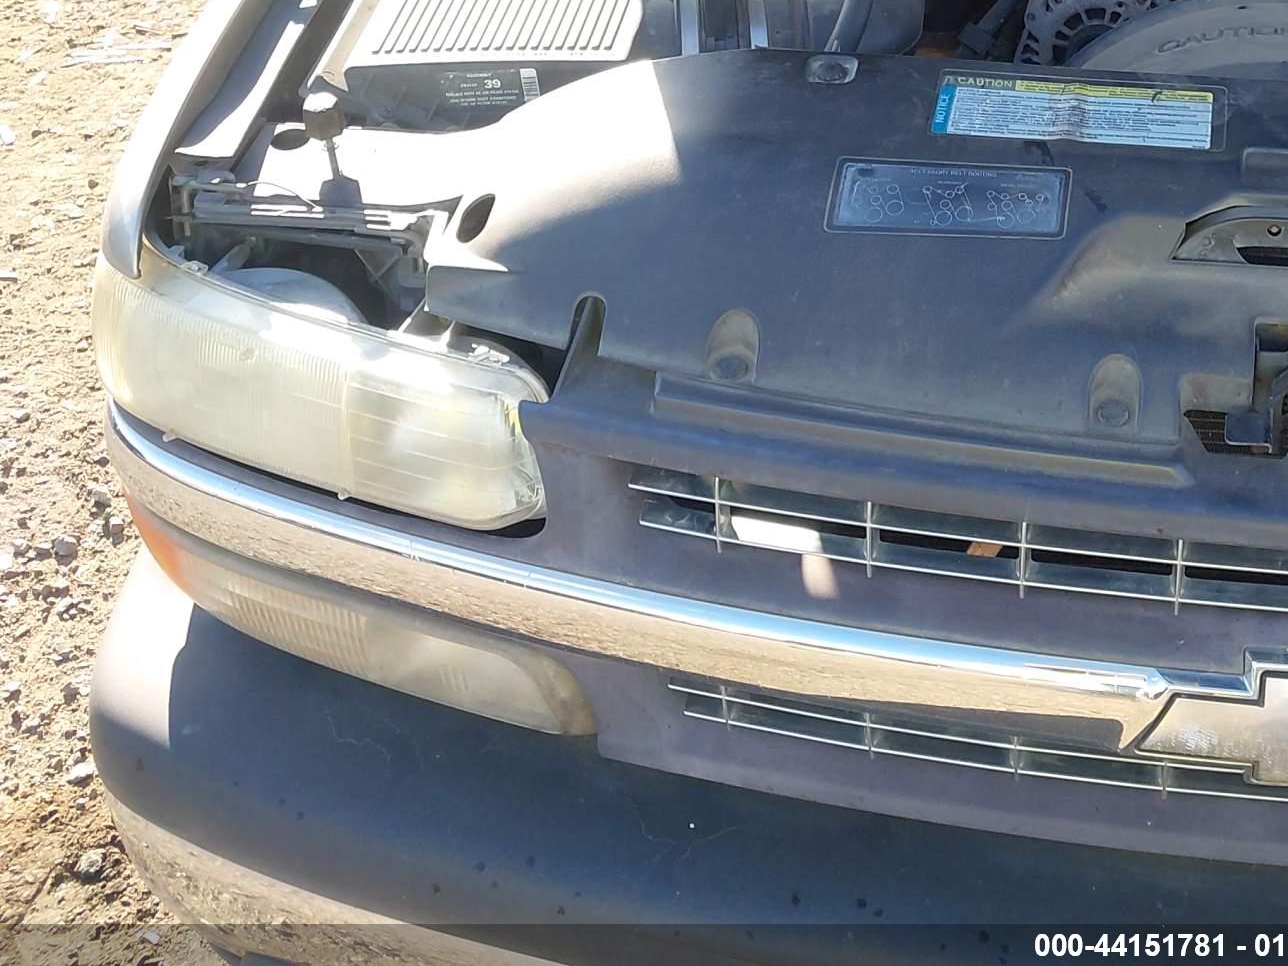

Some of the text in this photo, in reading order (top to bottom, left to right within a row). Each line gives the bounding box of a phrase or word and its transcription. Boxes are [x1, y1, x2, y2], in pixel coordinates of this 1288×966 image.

[483, 78, 501, 89] 39
[957, 76, 1013, 88] CAUTION
[935, 93, 951, 123] NOTICE
